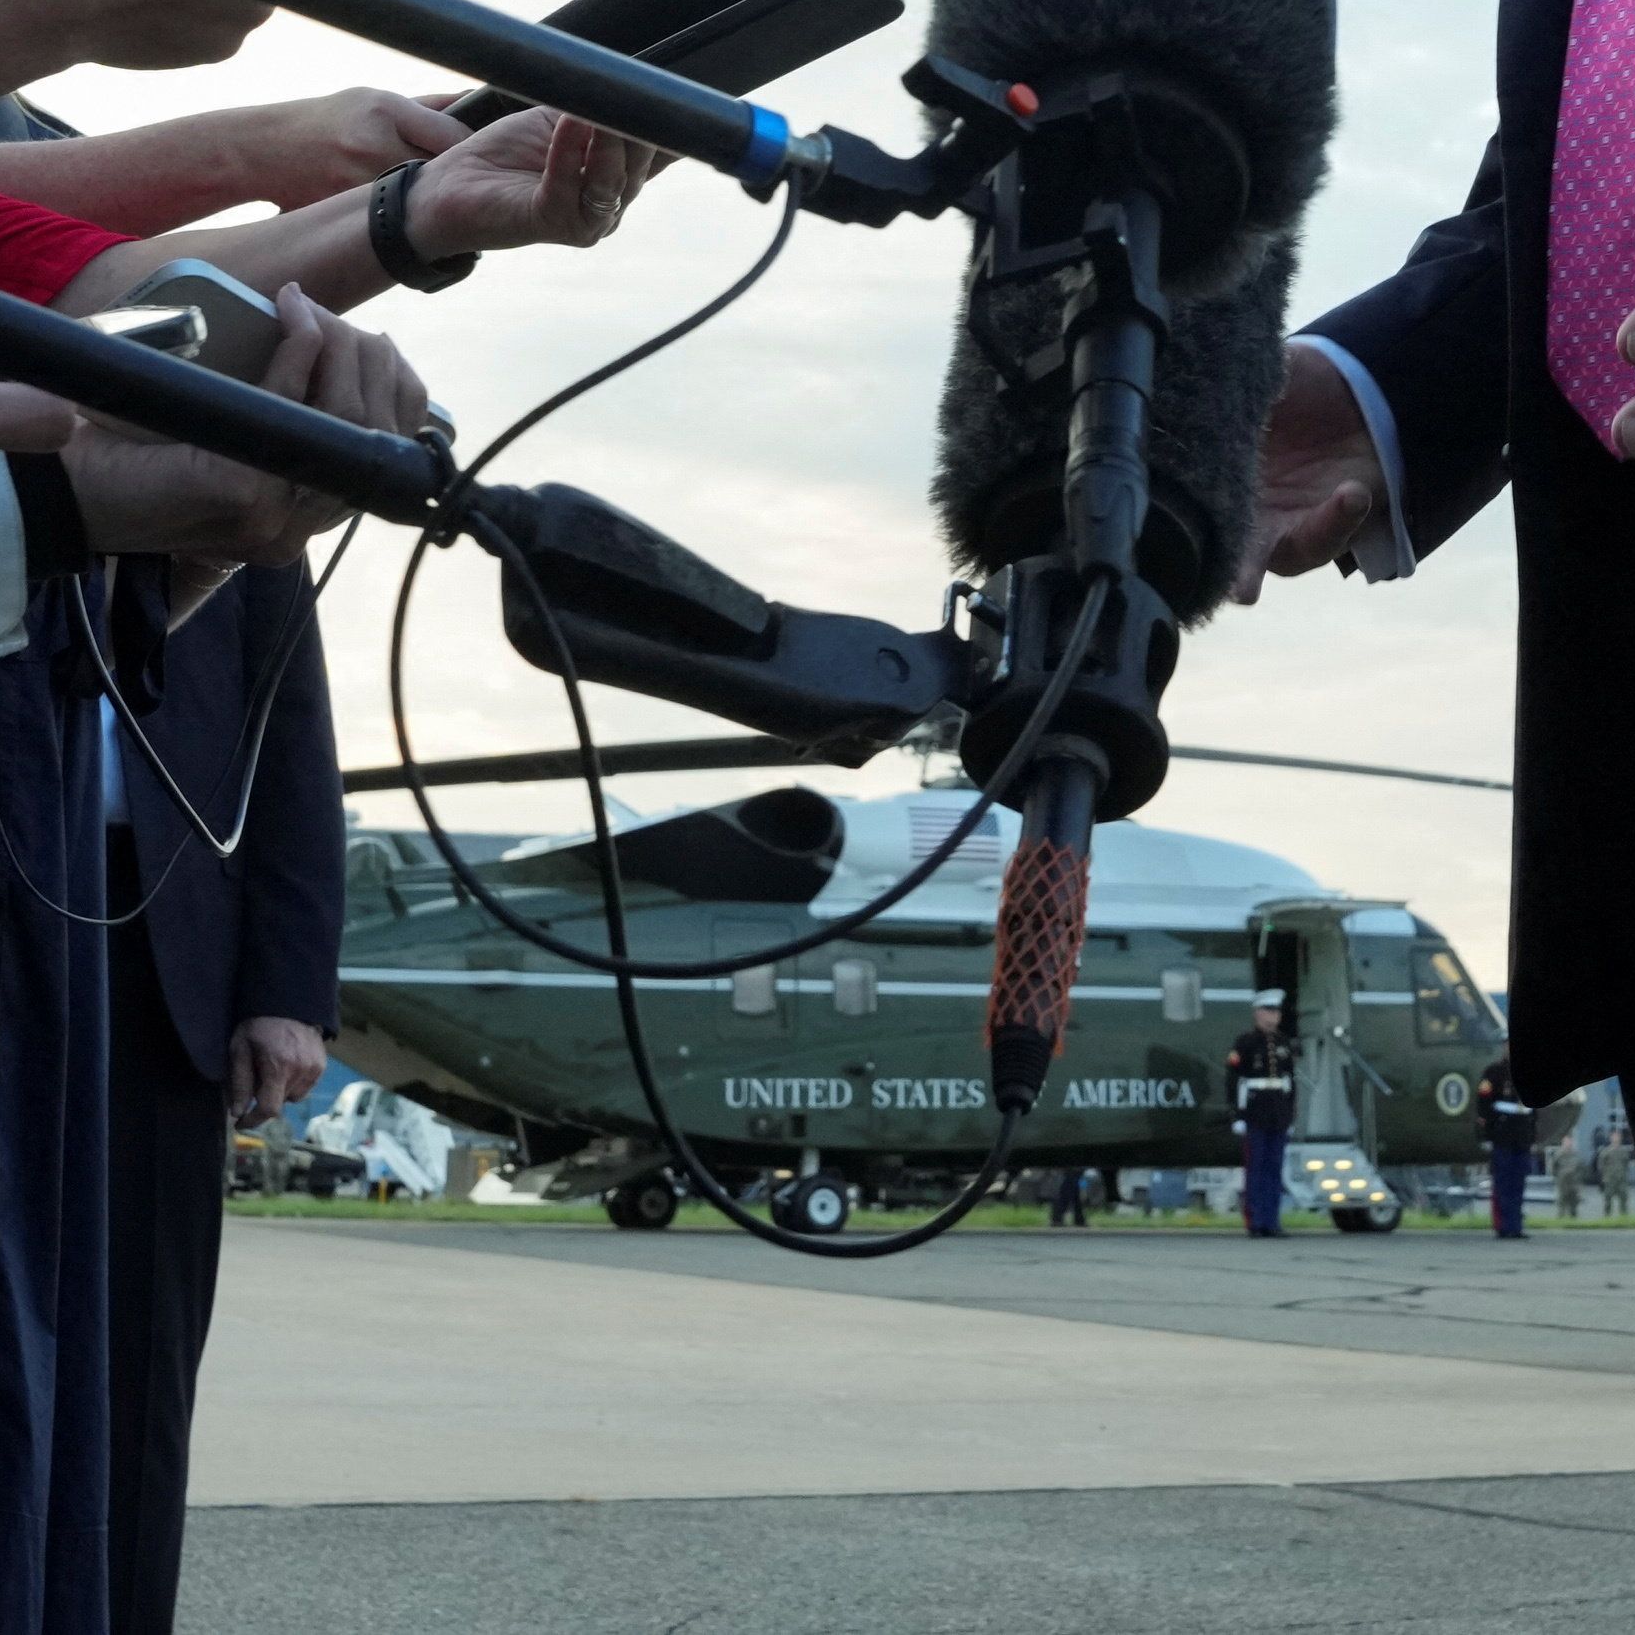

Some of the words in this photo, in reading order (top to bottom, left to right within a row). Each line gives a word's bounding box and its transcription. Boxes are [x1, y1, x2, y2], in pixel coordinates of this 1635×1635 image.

[722, 1077, 853, 1109] UNITED
[871, 1077, 986, 1109] STATES
[1062, 1077, 1198, 1109] AMERICA
